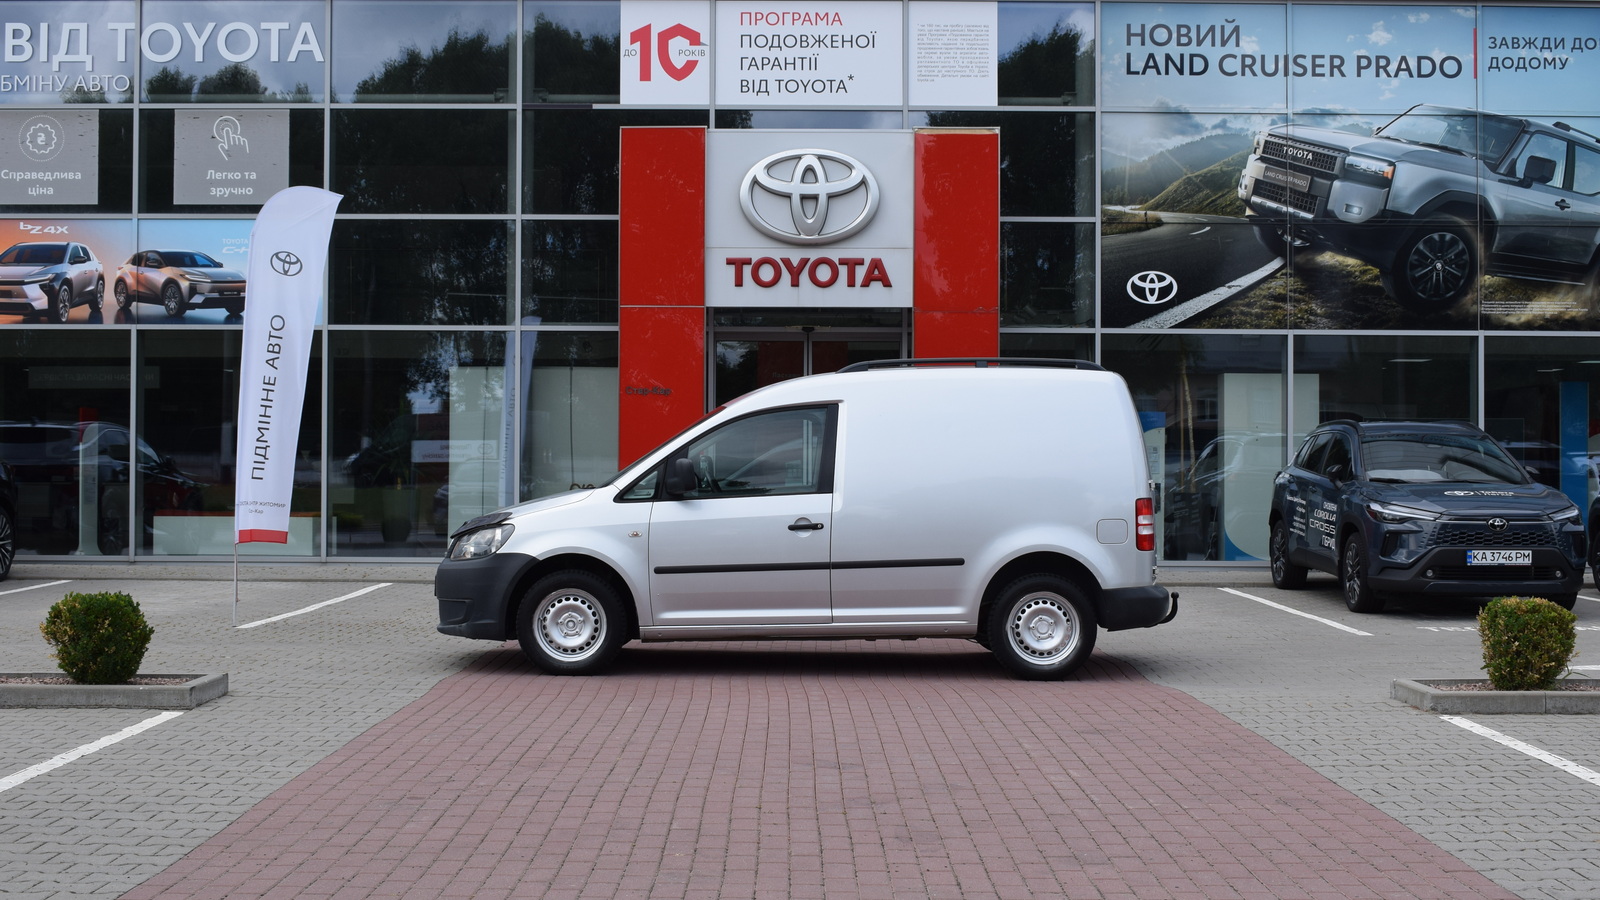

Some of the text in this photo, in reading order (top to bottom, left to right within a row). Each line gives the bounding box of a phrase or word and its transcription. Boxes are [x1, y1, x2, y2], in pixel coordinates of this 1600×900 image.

[740, 12, 843, 26] ПРОГРАМА
[1126, 18, 1240, 47] НОВИЙ
[4, 22, 325, 72] ВІД TOYOTA
[740, 31, 876, 51] ПОДОВЖЕНОЇ
[1488, 36, 1600, 53] ЗАВЖДИ ДО
[623, 49, 637, 57] ДО
[678, 49, 705, 57] РОКІВ
[740, 54, 818, 71] ГАРАНТІЇ
[1126, 53, 1463, 79] LAND CRUISER PRADO
[1487, 56, 1569, 72] ДОДОМУ
[0, 75, 131, 93] БМІНУ АВТО
[740, 80, 770, 96] ВІД
[1283, 147, 1313, 160] TOYOTA
[1, 170, 82, 182] Справедлива
[206, 170, 257, 181] Легко та
[28, 185, 54, 196] ціна
[210, 186, 253, 198] зручно
[726, 256, 893, 288] TOYOTA
[251, 314, 286, 480] ПІДМІННЕ АВТО
[625, 386, 671, 396] Стар-Кар
[1313, 508, 1337, 522] COROLLA
[1309, 519, 1336, 535] CROSS
[1490, 551, 1514, 562] 3746
